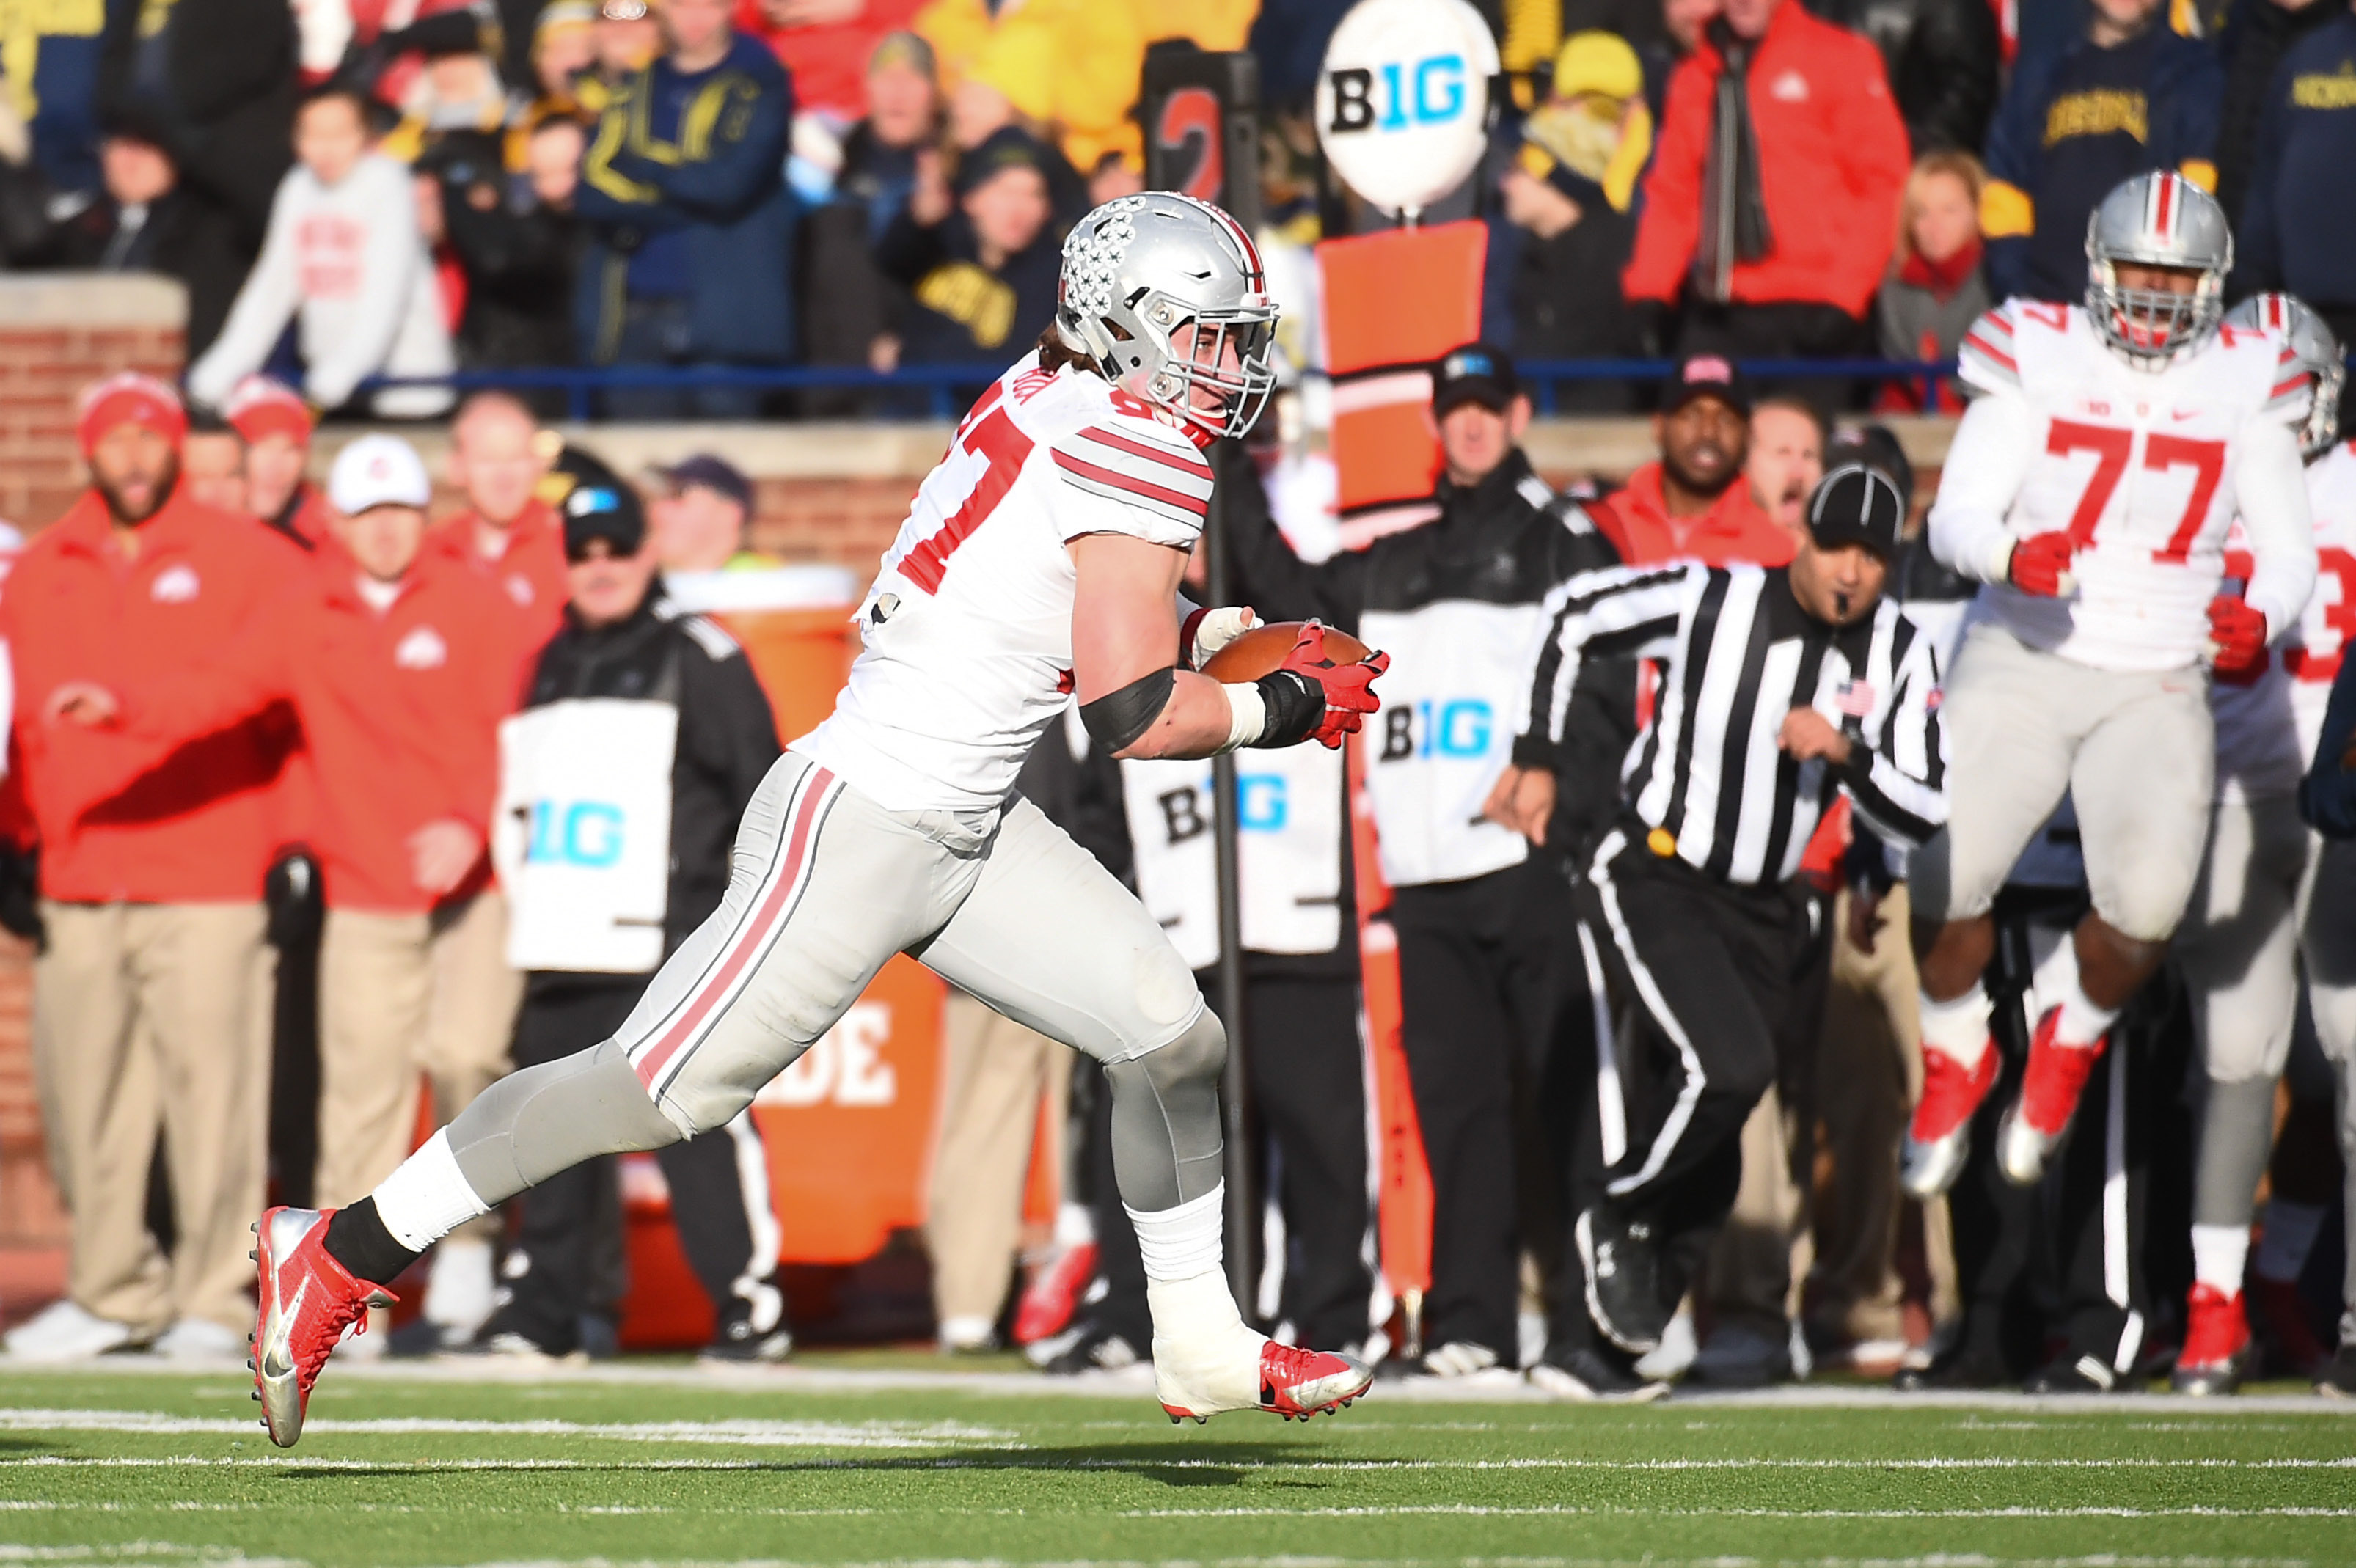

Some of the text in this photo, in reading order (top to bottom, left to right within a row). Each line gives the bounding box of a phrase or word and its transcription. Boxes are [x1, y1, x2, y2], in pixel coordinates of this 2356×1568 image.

[2046, 415, 2228, 565] 77
[512, 799, 626, 868] 1G
[1157, 772, 1288, 846] BG
